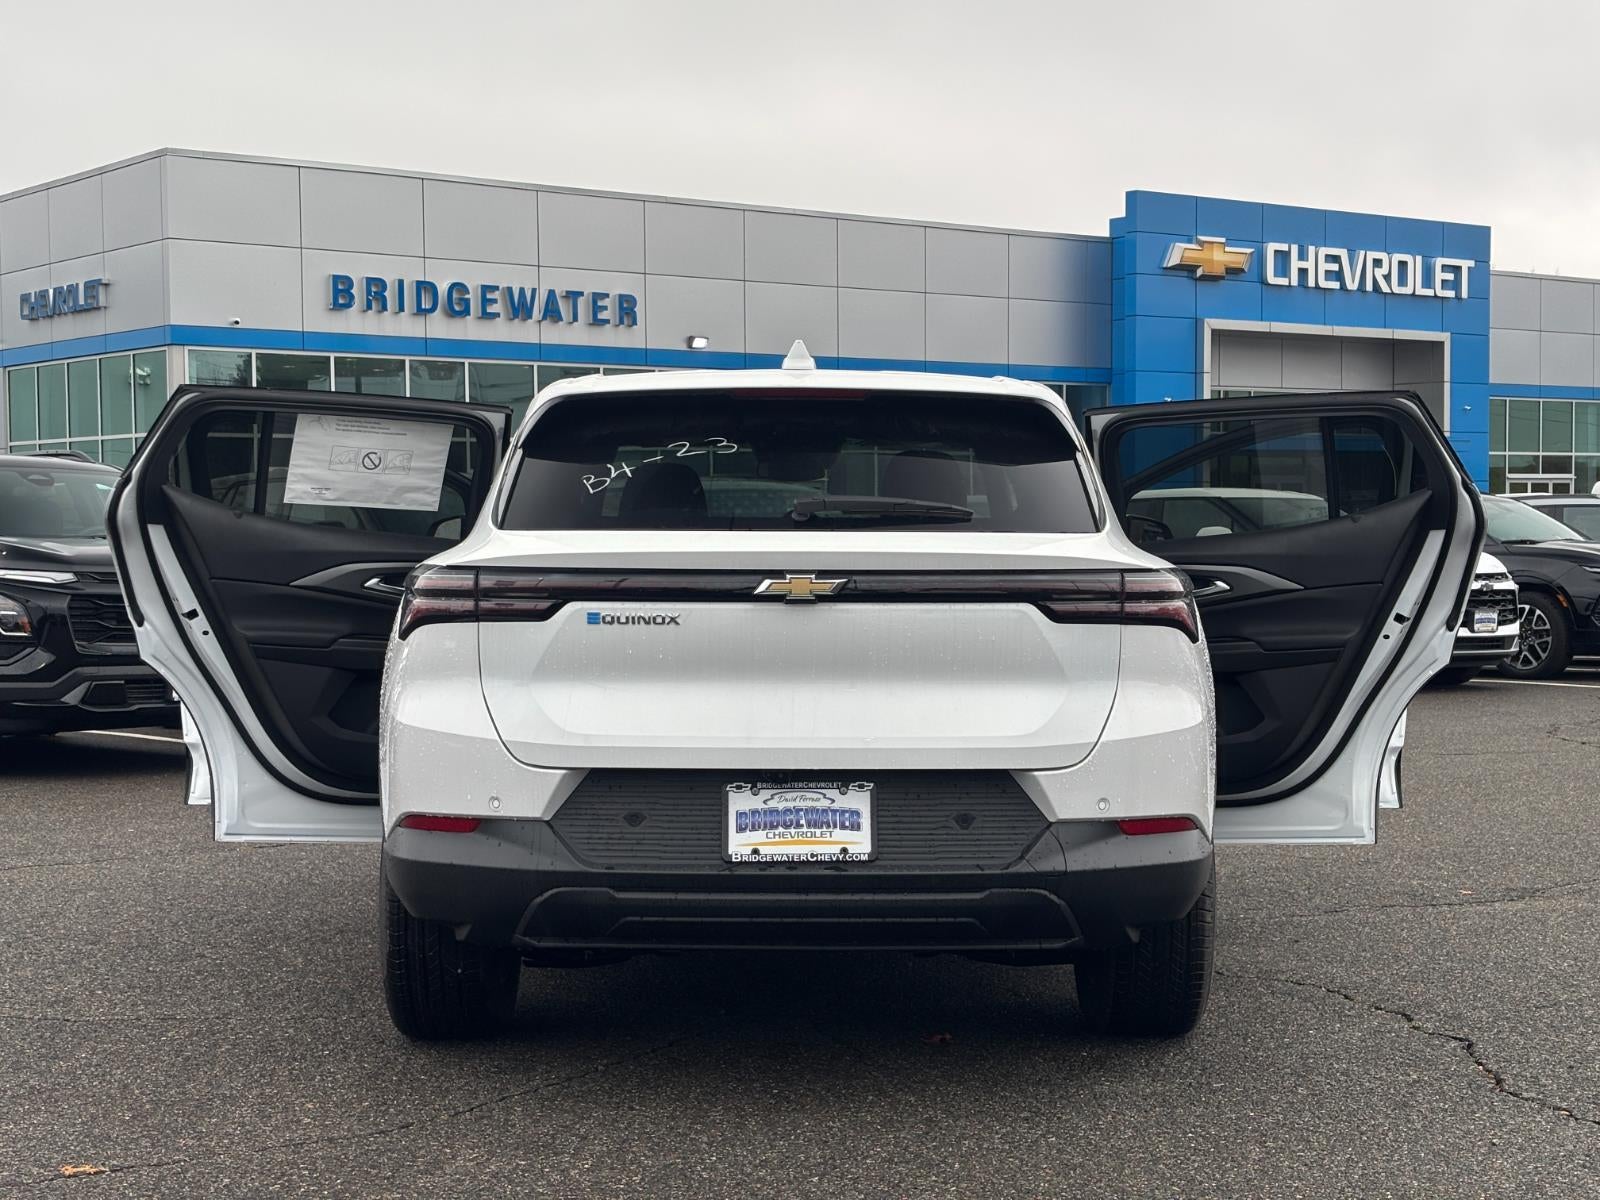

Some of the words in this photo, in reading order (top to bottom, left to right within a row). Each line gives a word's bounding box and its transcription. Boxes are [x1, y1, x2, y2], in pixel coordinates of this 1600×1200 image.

[1265, 242, 1476, 299] CHEVROLET
[20, 278, 106, 321] CHEVROLET
[328, 273, 639, 328] BRIDGEWATER
[586, 612, 681, 626] EQUINOX
[735, 806, 863, 834] BRIDGEWATER
[765, 830, 835, 839] CHEVROLET
